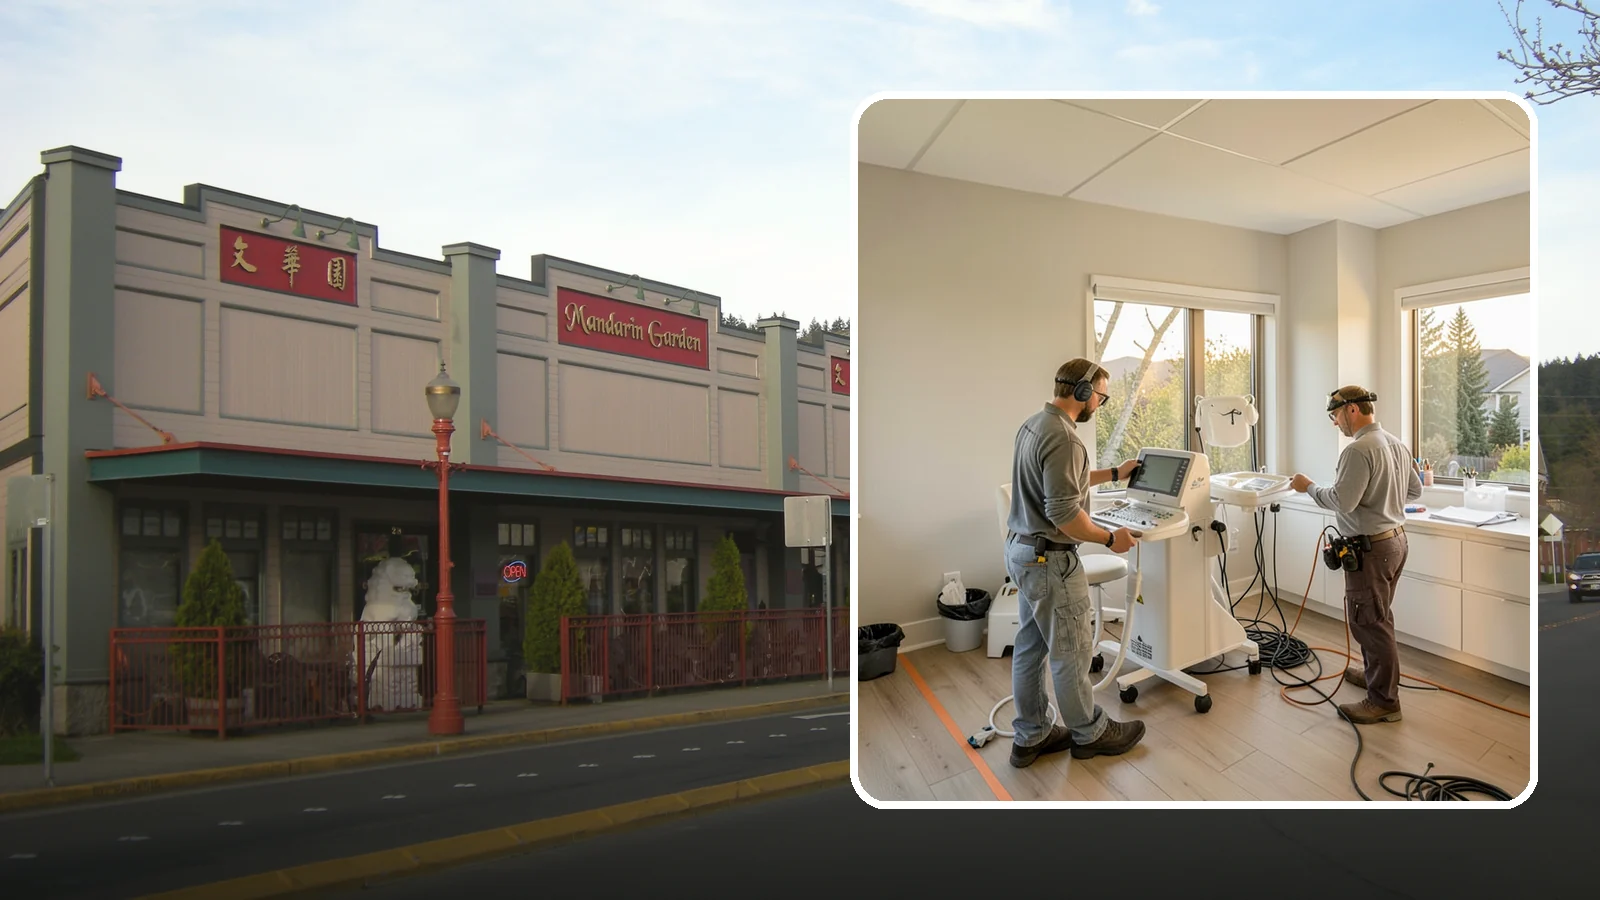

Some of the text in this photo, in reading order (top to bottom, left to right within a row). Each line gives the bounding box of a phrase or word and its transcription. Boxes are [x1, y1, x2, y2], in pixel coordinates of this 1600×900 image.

[231, 236, 346, 291] 文華園
[565, 302, 702, 352] Mandarin Garden
[503, 565, 527, 578] OPEN
